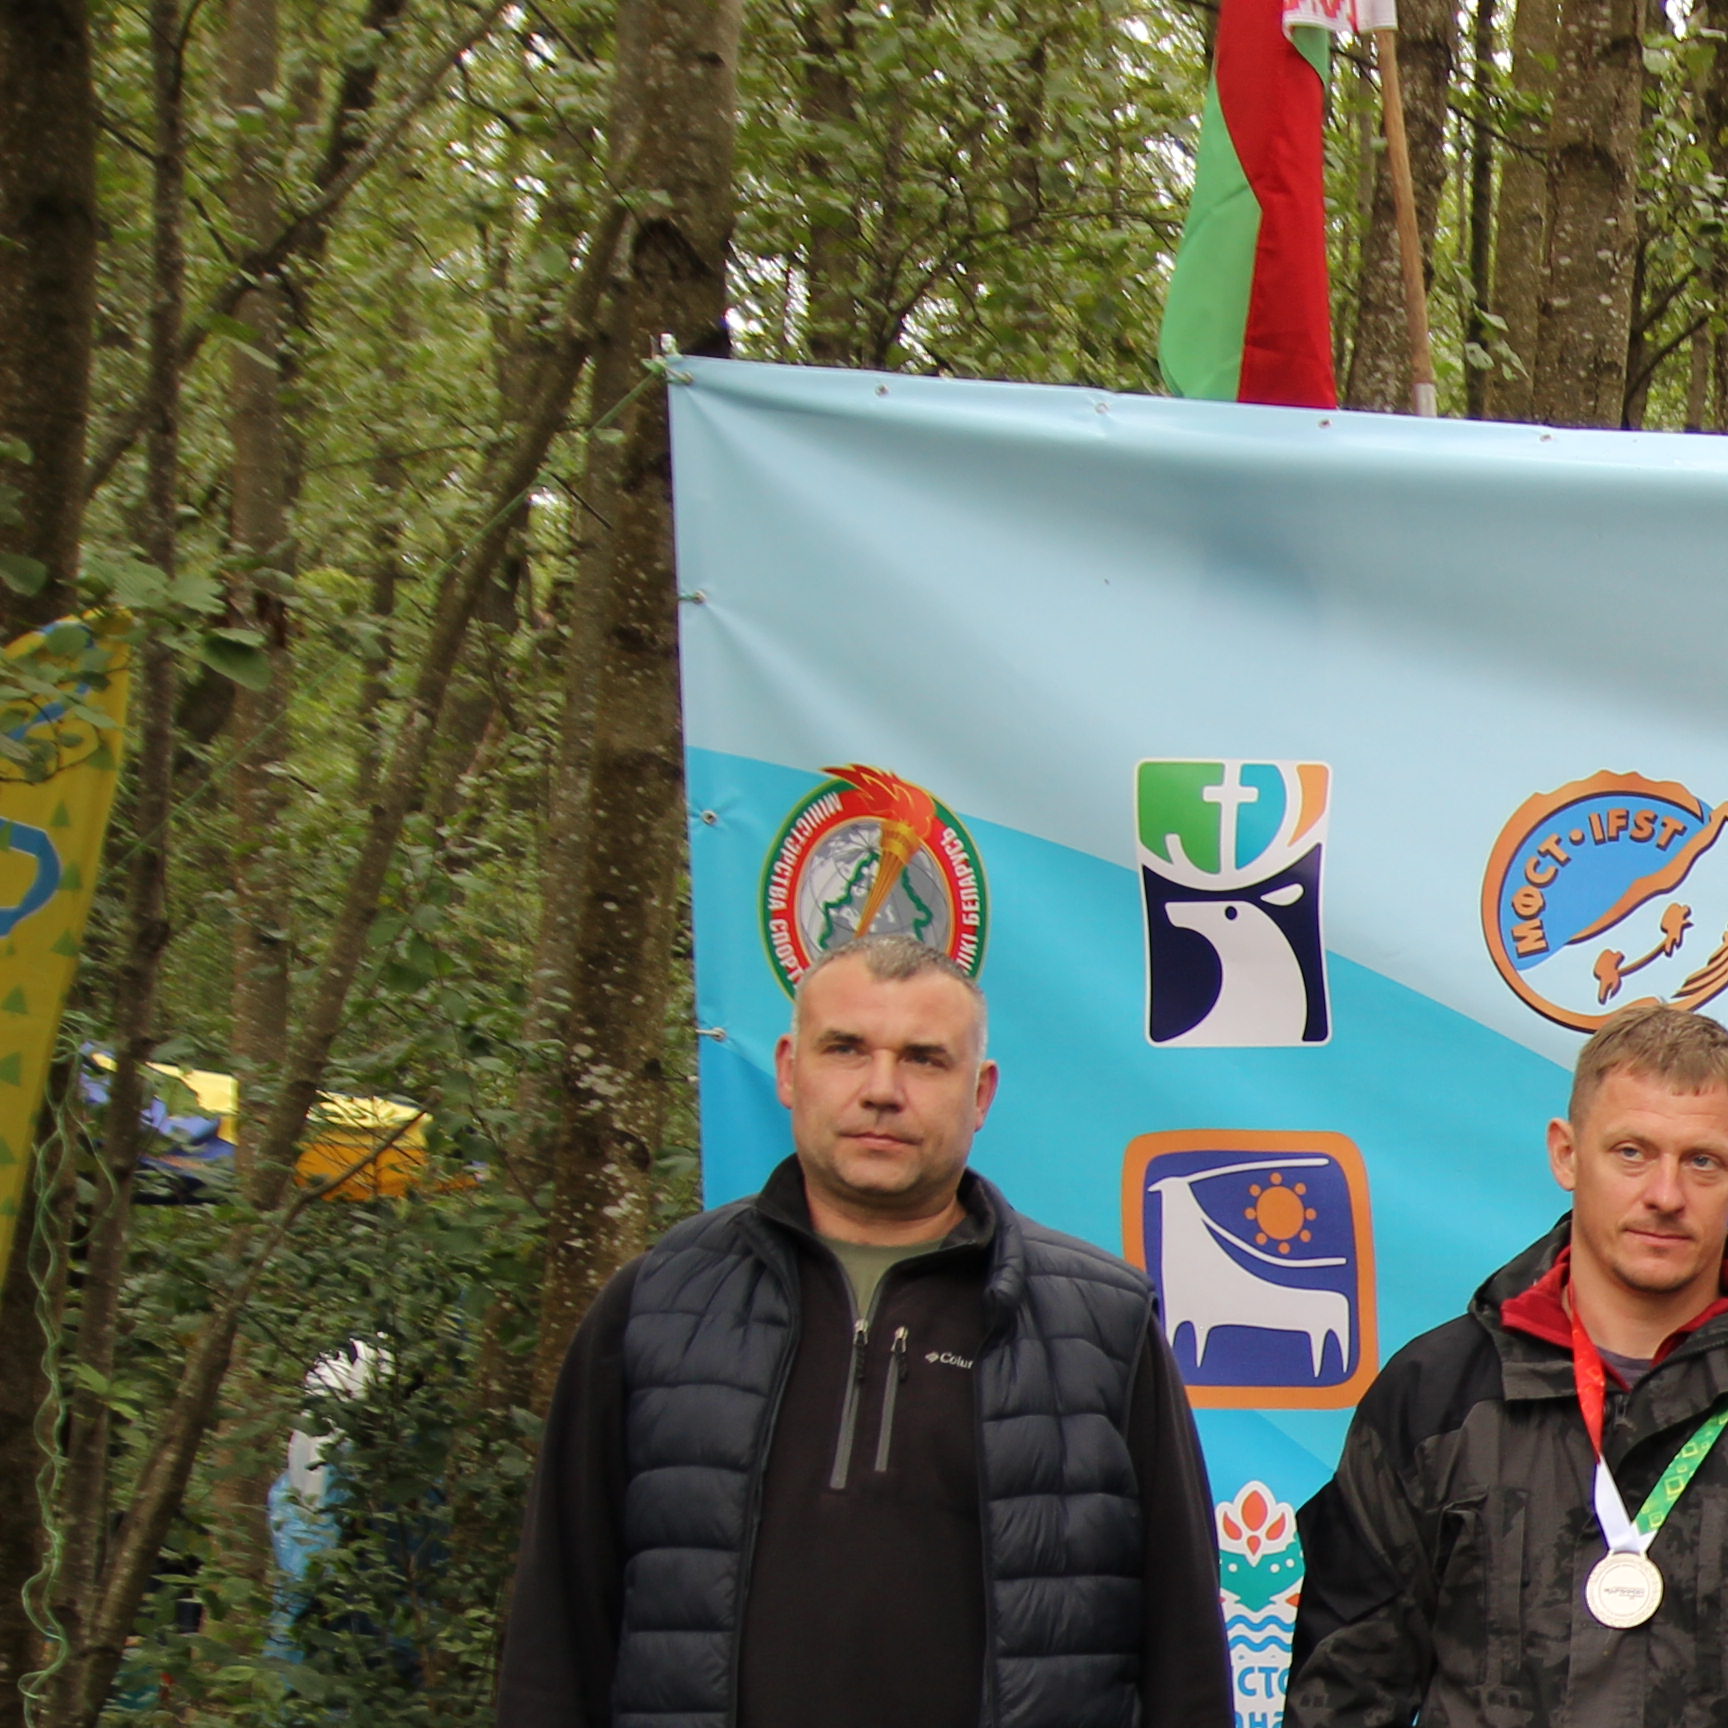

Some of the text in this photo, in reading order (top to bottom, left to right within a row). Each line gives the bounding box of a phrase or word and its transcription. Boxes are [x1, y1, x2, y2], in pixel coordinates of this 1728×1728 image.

[941, 827, 981, 927] БЕЛАРУСЬ
[1511, 833, 1572, 959] МФСТ
[769, 918, 807, 989] СПОРТ
[940, 1351, 973, 1369] Colu
